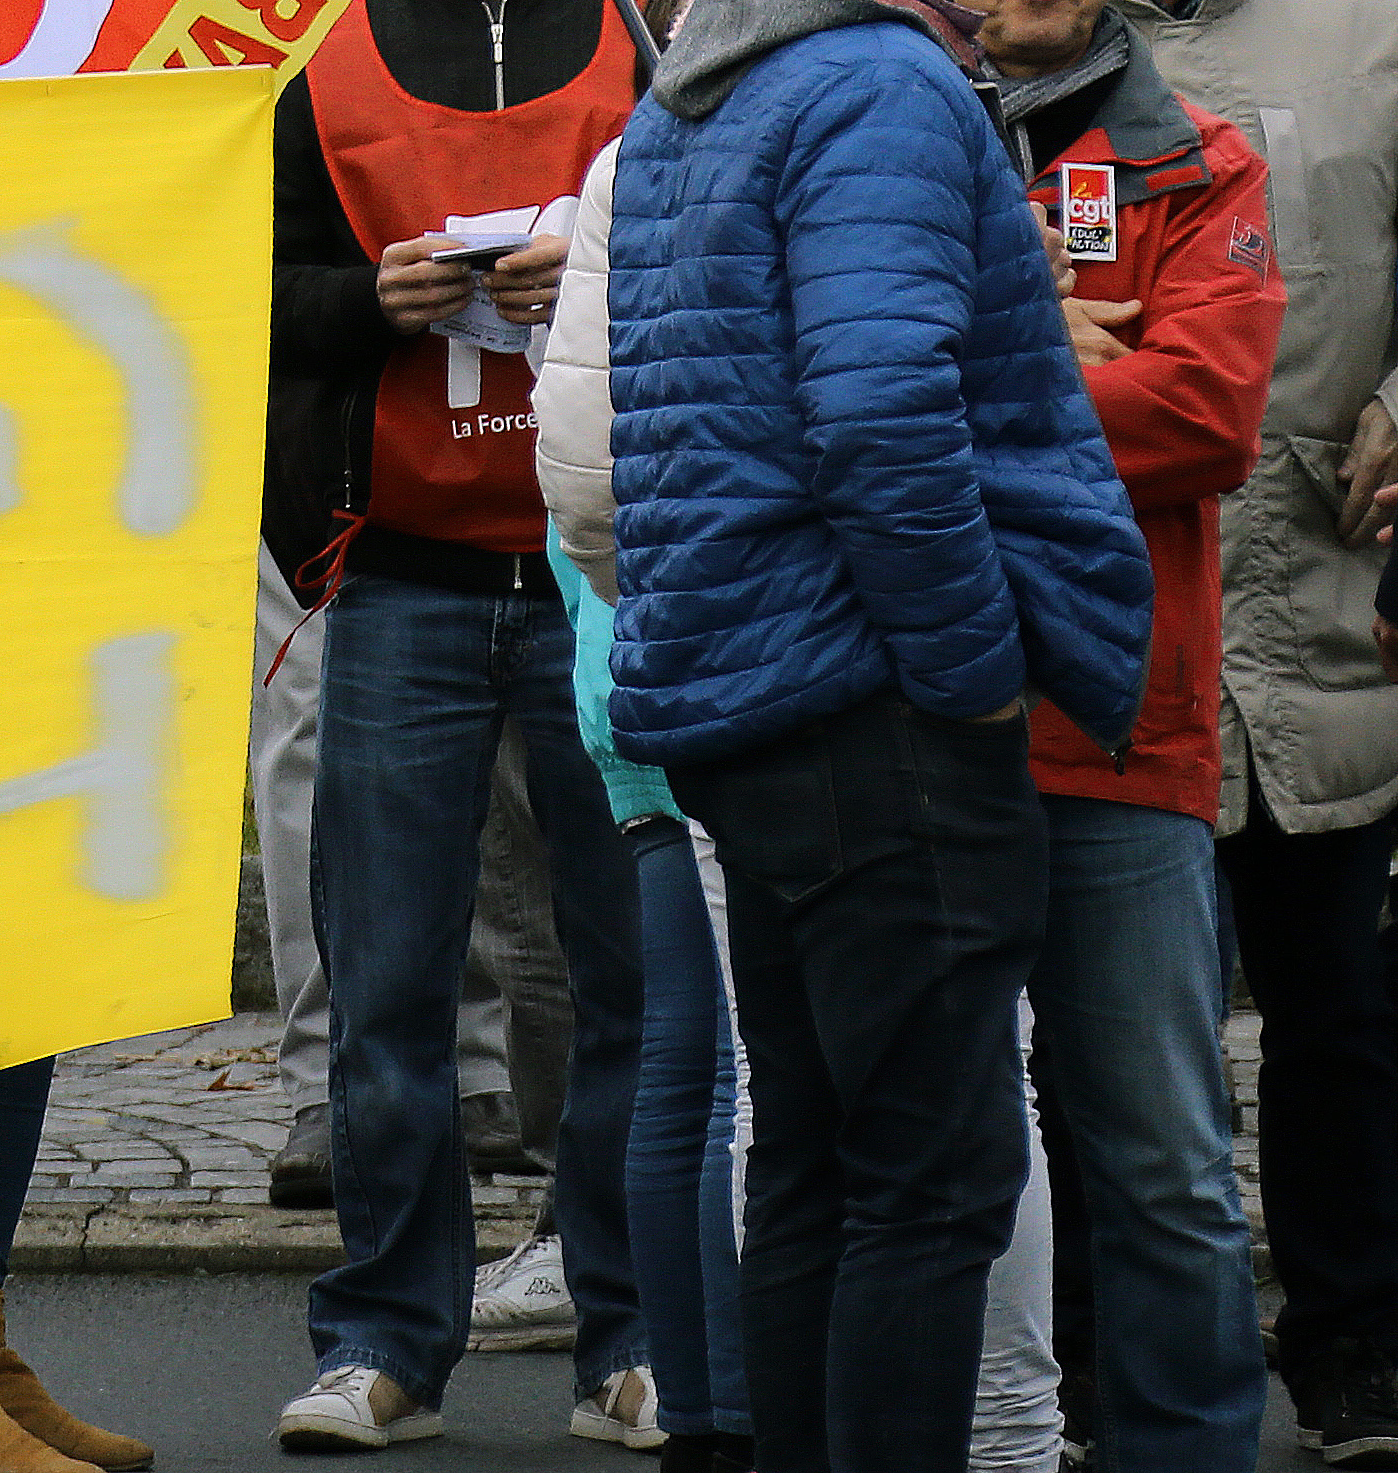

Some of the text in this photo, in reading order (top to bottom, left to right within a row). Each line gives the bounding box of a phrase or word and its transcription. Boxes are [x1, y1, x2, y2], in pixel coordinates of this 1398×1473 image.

[1069, 195, 1112, 224] cgt
[451, 412, 540, 440] La Force
